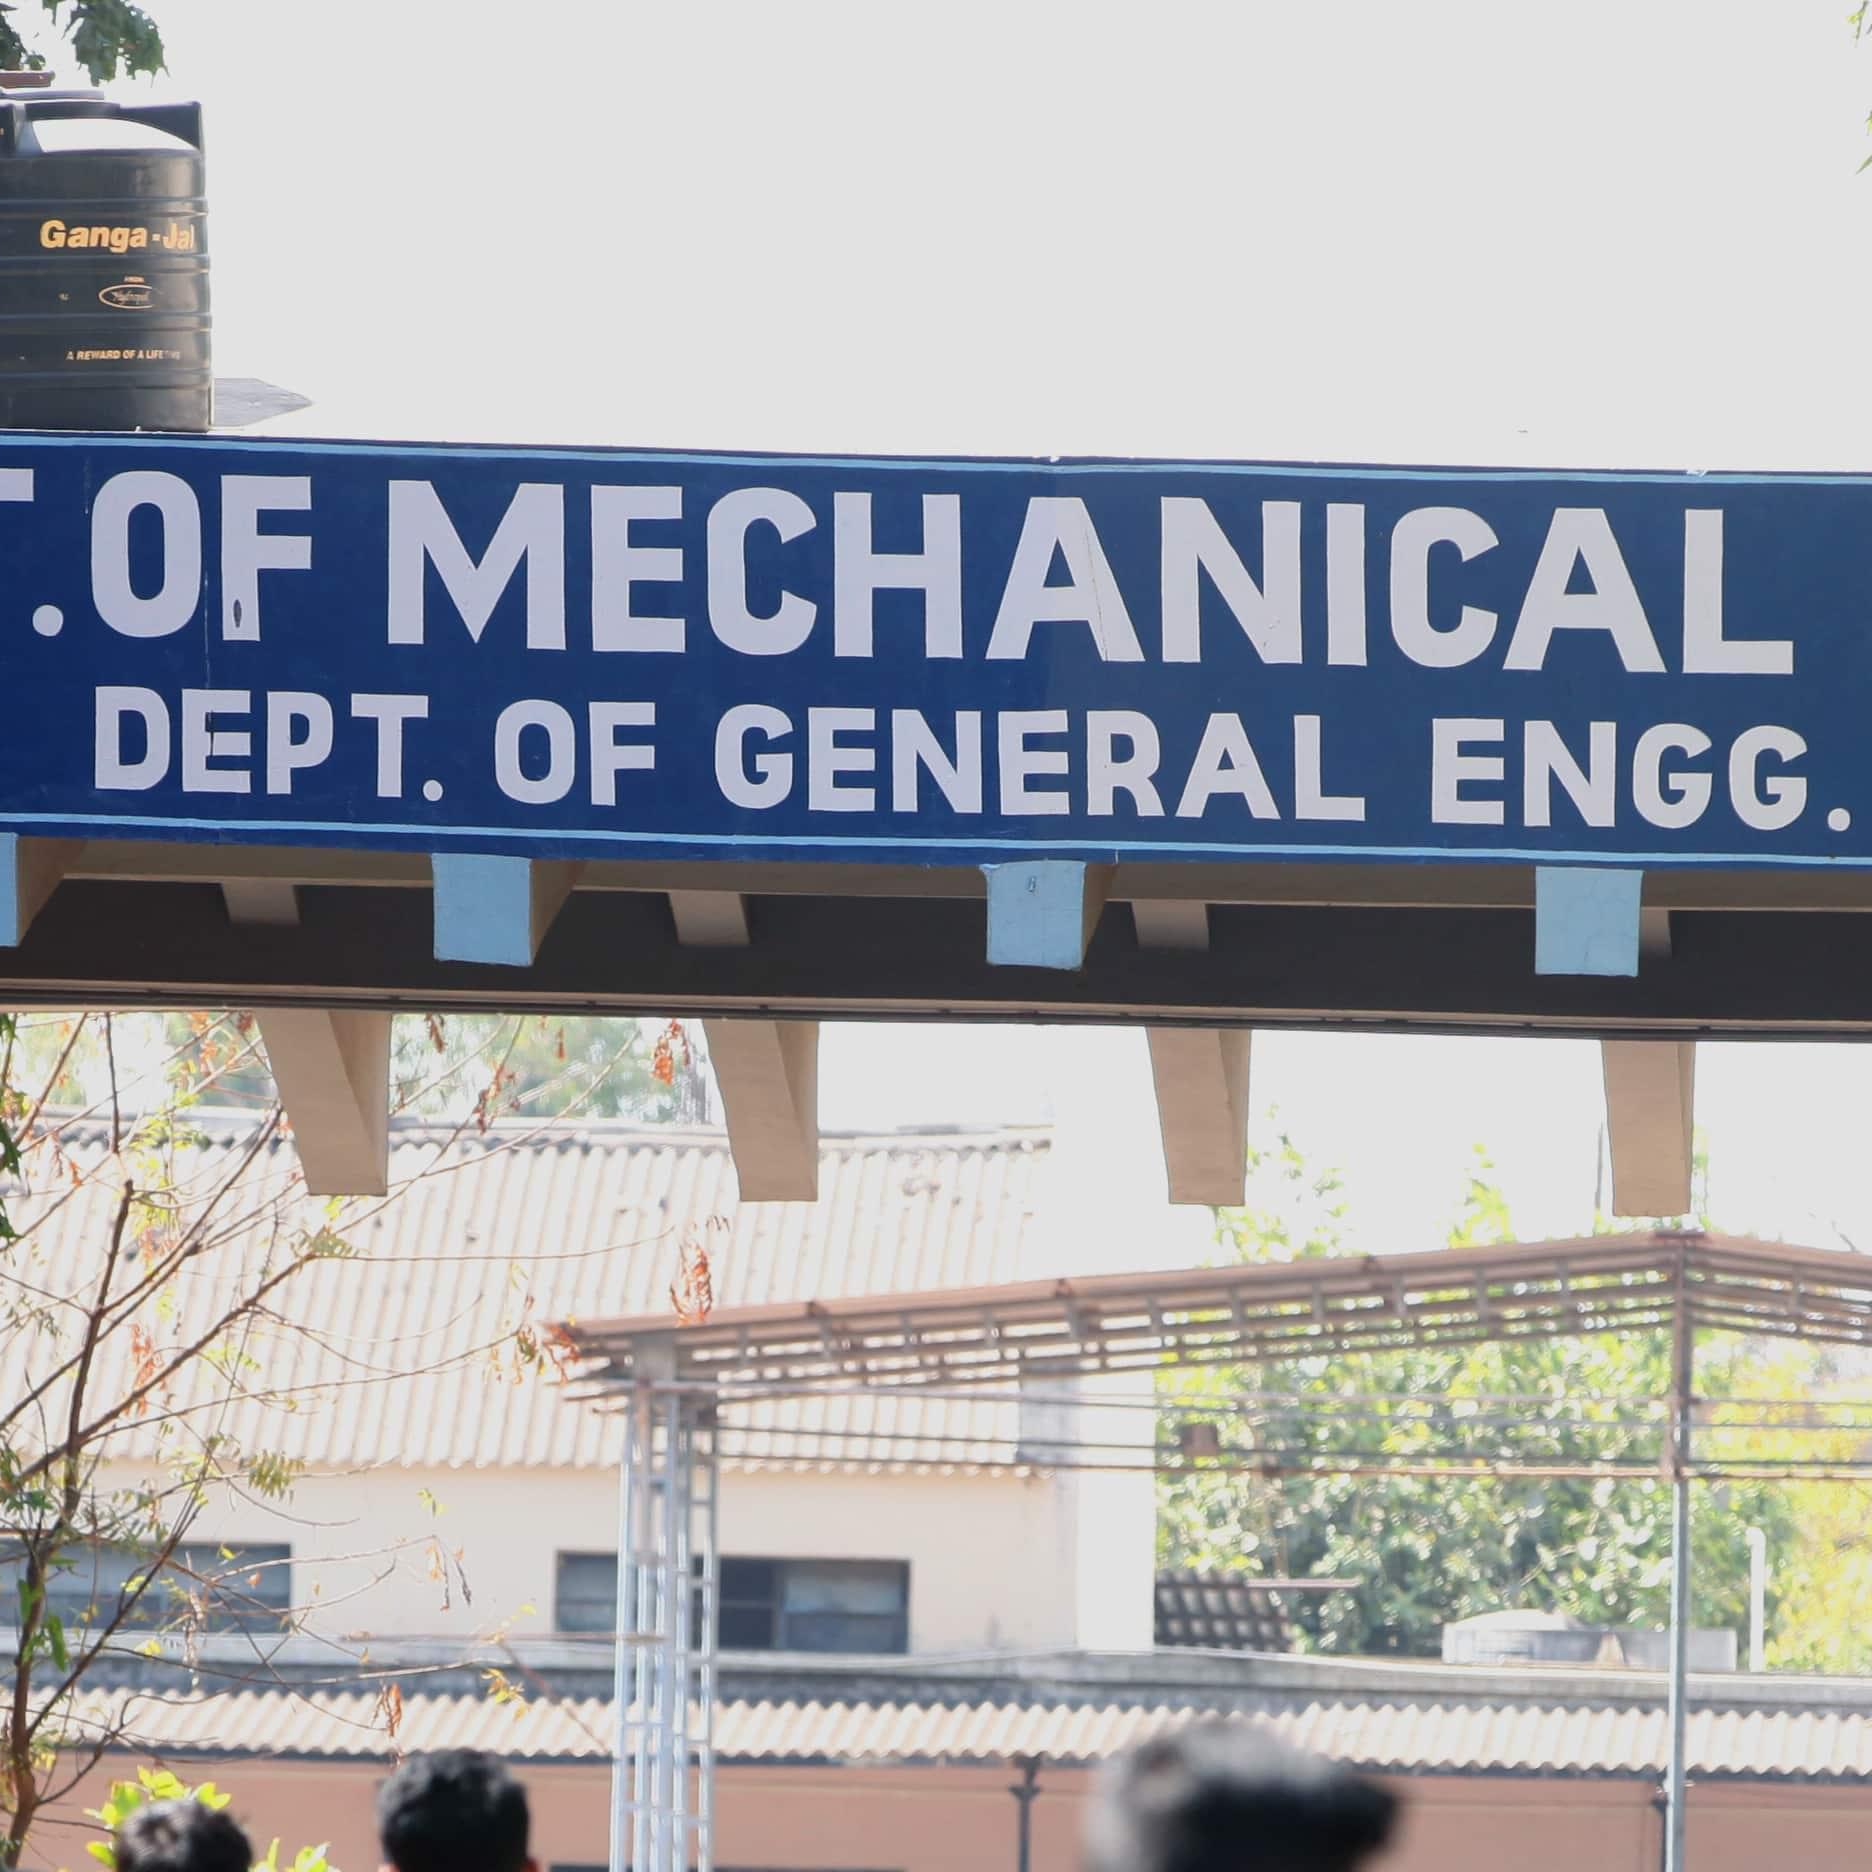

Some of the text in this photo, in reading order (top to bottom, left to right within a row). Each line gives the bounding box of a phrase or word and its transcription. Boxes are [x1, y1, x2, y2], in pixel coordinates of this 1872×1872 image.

[386, 478, 1795, 676] MECHANICAL
[94, 685, 1852, 833] DEPT. OF GENERAL ENGG.
